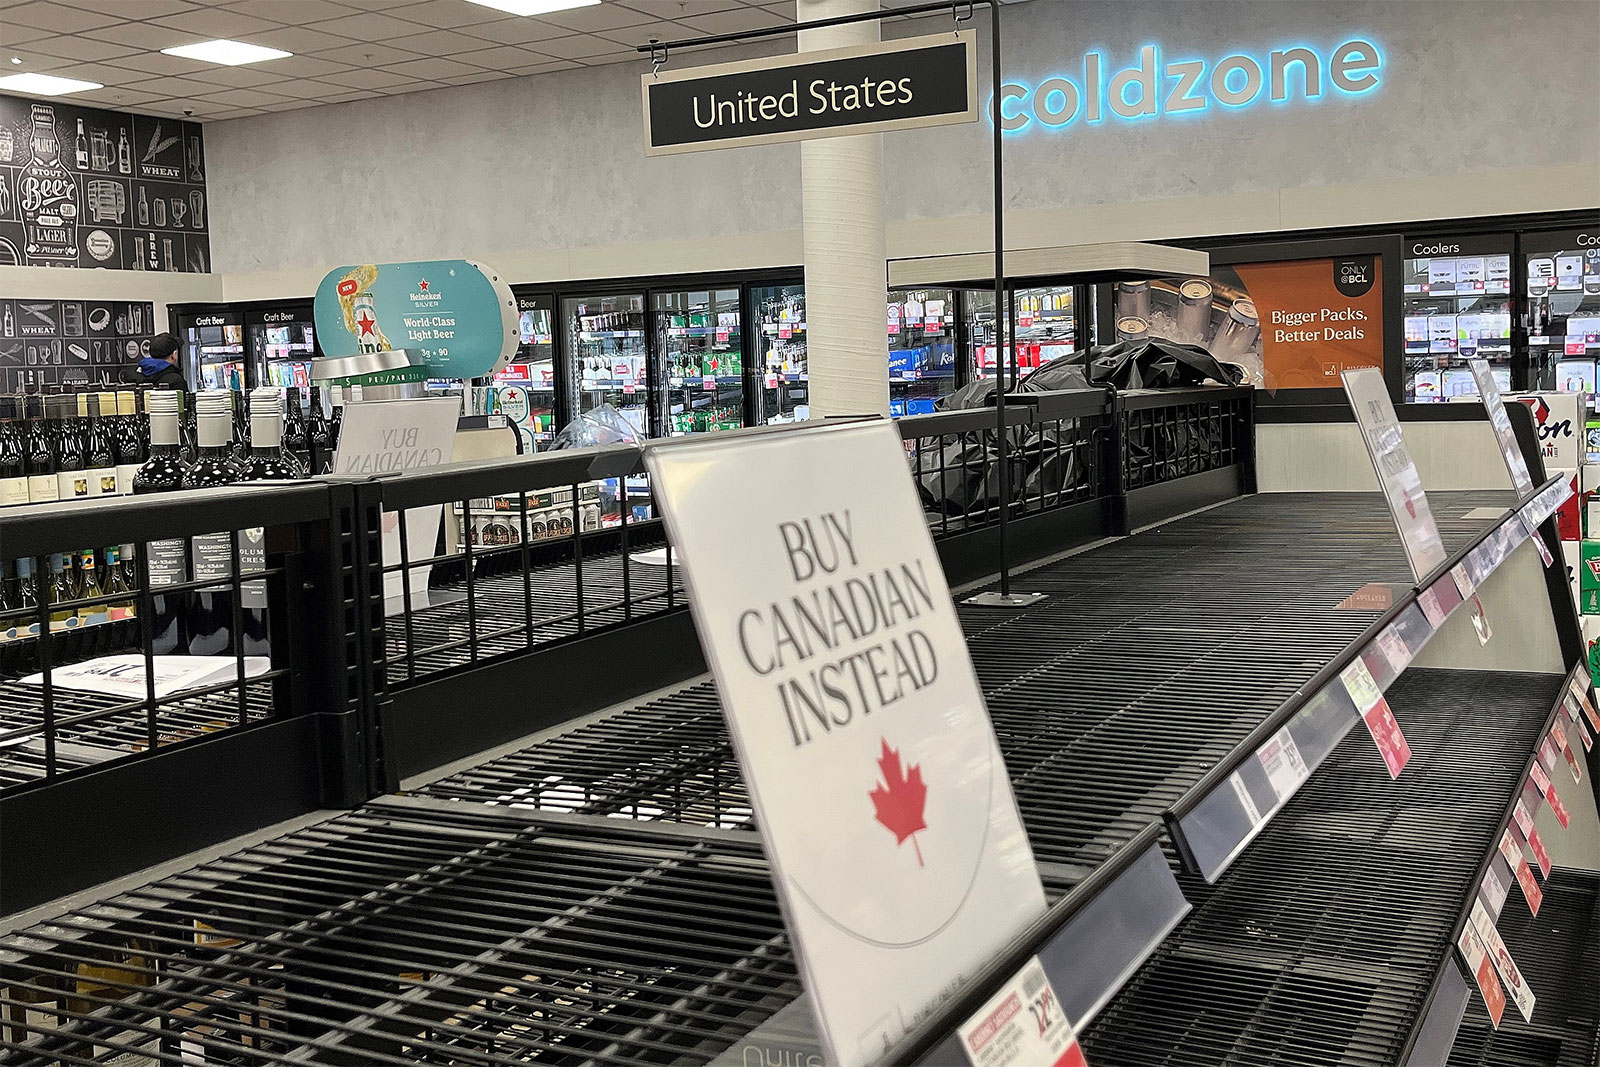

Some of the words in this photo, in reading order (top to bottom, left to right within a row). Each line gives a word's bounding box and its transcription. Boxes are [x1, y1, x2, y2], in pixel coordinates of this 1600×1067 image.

[991, 40, 1379, 130] coldzone
[693, 79, 798, 128] United
[809, 76, 913, 115] States
[31, 168, 61, 177] STOUT
[141, 166, 180, 177] WHEAT
[20, 177, 75, 211] Beer
[40, 207, 59, 215] MALT
[36, 228, 67, 243] LAGER
[149, 232, 159, 269] BREW
[1413, 243, 1460, 255] Coolers
[1341, 265, 1367, 276] ONLY
[1341, 274, 1367, 284] @BCL
[409, 292, 442, 301] Heineken
[520, 299, 536, 308] Beer
[196, 317, 212, 326] Craft
[212, 316, 225, 325] Beer
[264, 313, 280, 322] Craft
[280, 312, 294, 321] Beer
[403, 317, 456, 327] World-Class
[1271, 311, 1317, 326] Bigger
[1320, 307, 1368, 322] Packs,
[22, 327, 56, 335] WHEAT
[408, 330, 432, 341] Light
[432, 330, 455, 339] Beer
[1275, 328, 1320, 343] Better
[1323, 326, 1365, 340] Deals
[421, 348, 431, 358] 3g
[438, 348, 448, 356] 90
[889, 357, 907, 367] anee
[1537, 419, 1572, 440] on
[778, 509, 858, 582] BUY
[737, 558, 935, 675] CANADIAN
[777, 629, 938, 747] INSTEAD
